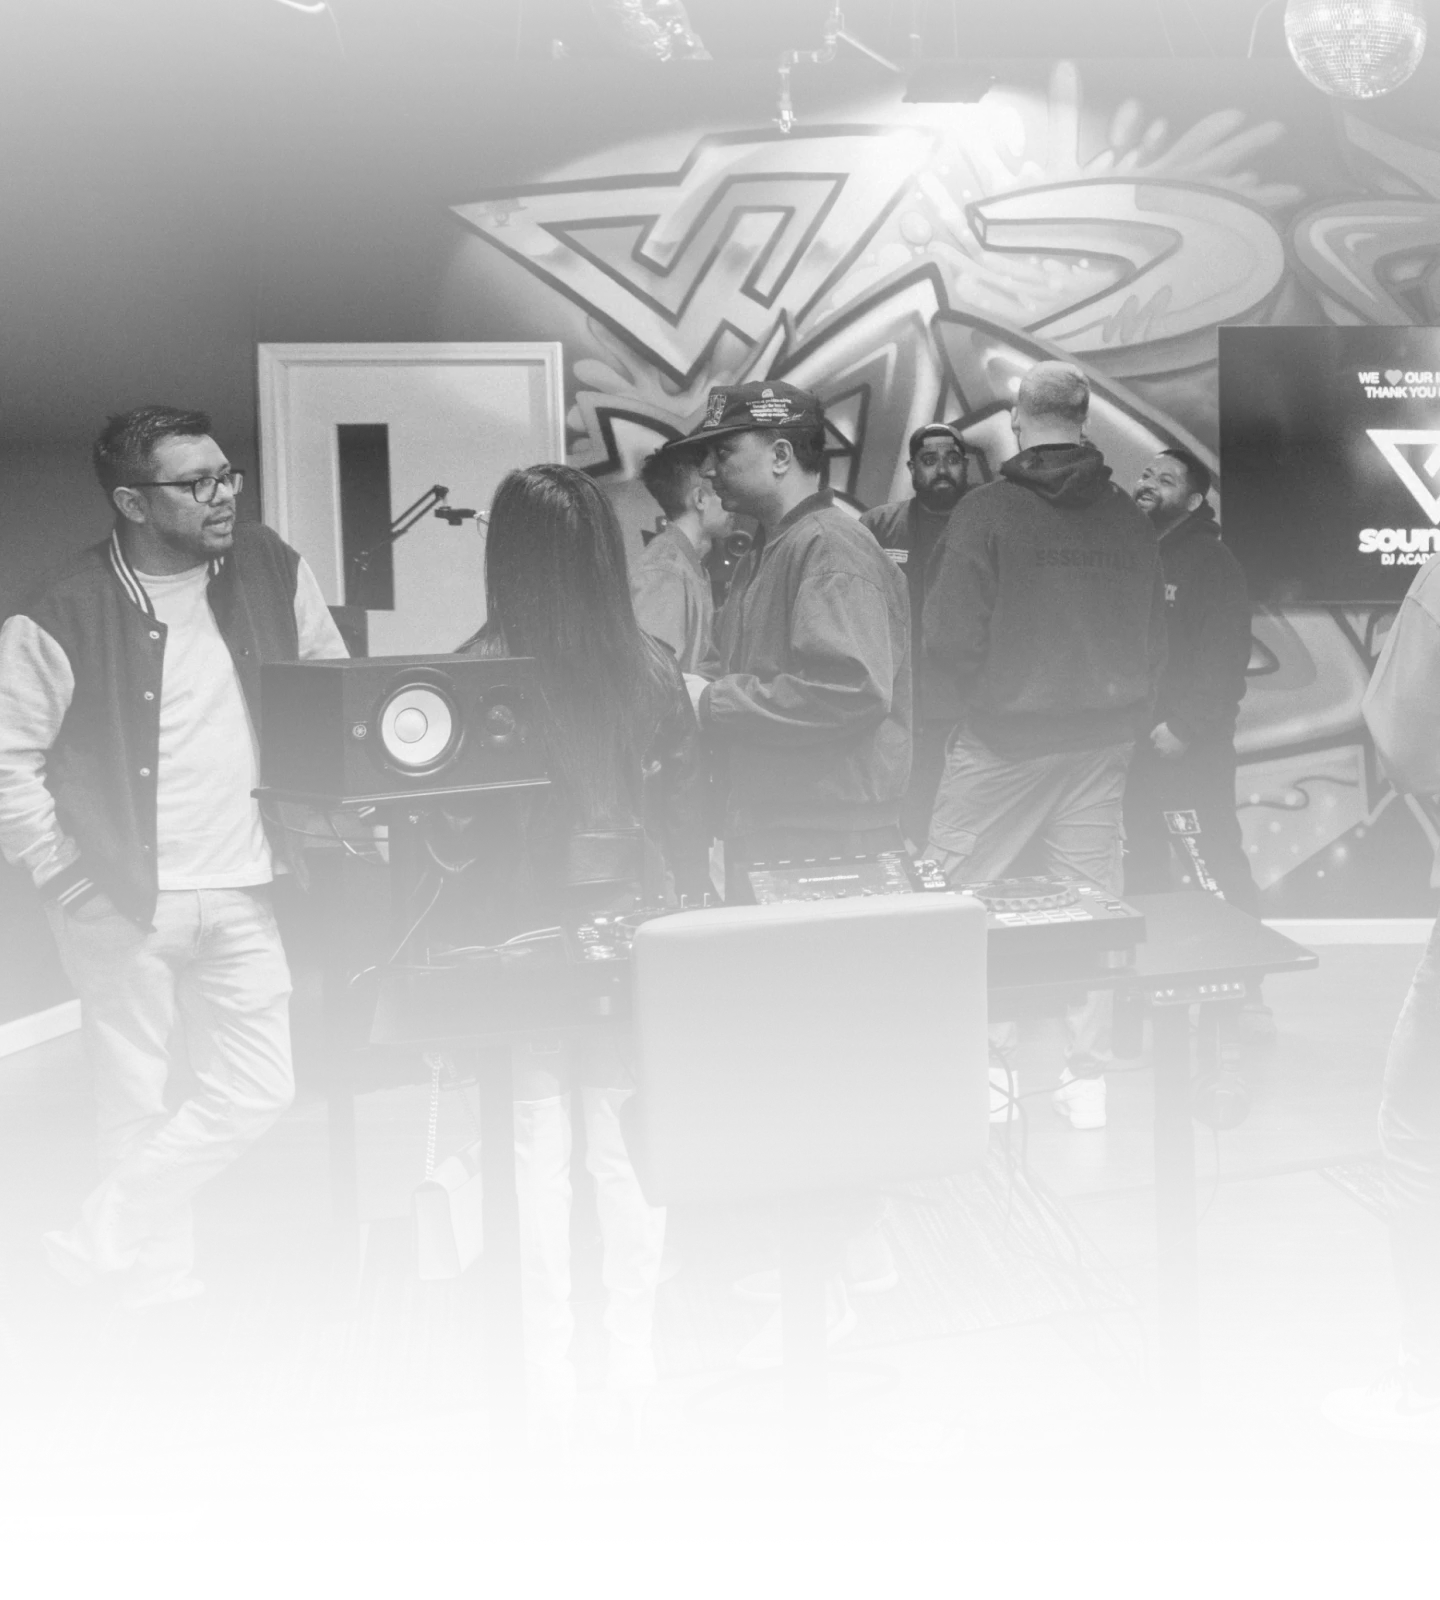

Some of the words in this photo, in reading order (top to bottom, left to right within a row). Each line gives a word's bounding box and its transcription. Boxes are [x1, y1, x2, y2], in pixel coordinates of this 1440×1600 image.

[1358, 372, 1380, 384] WE
[1404, 372, 1433, 384] OUR
[1364, 386, 1408, 398] THANK
[1409, 386, 1436, 398] YOU
[1381, 553, 1395, 565] DJ
[1396, 553, 1435, 565] ACAD
